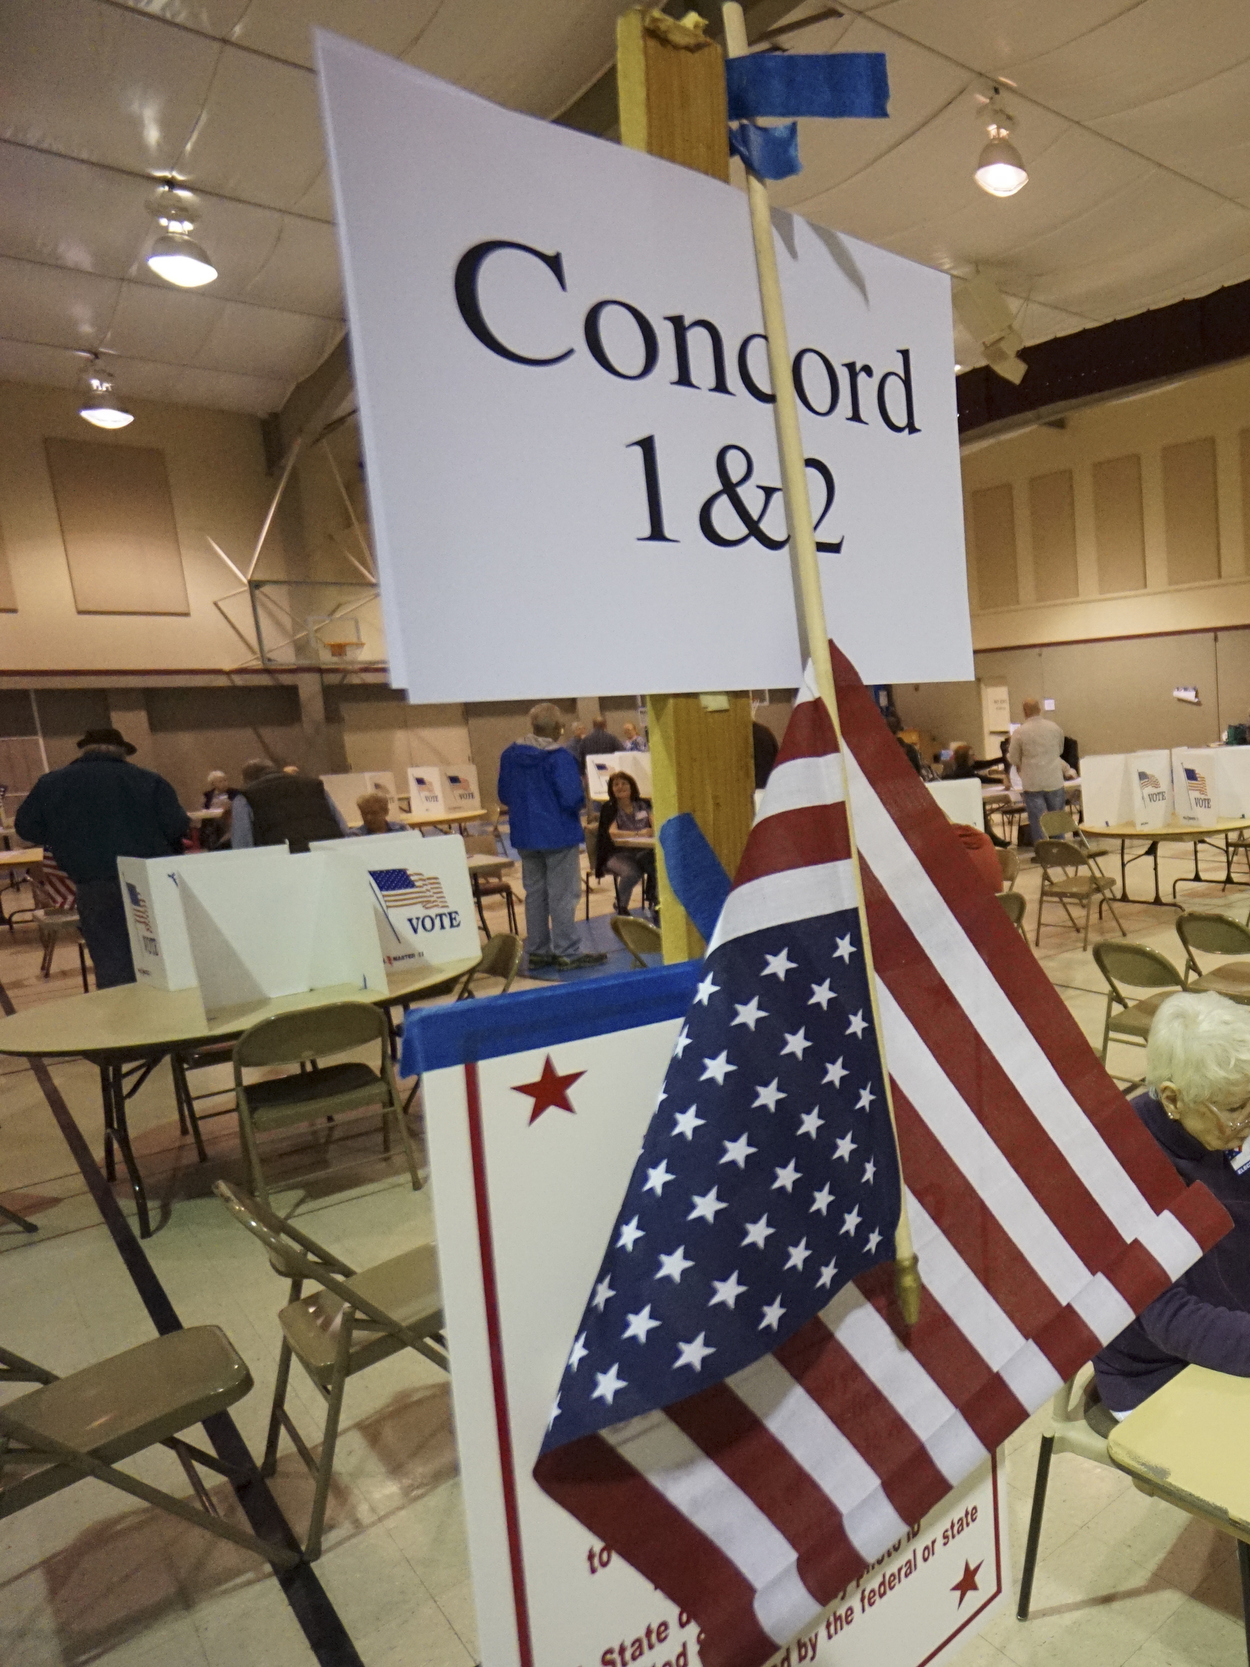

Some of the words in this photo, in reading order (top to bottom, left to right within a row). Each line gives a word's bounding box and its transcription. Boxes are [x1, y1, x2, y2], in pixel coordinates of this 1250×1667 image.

[454, 239, 921, 436] Concord
[624, 433, 845, 554] 1&2
[425, 795, 439, 803] VOTE
[458, 792, 475, 801] VOTE
[1148, 791, 1167, 803] VOTE
[1194, 797, 1212, 809] VOTE
[407, 910, 462, 935] VOTE
[586, 1544, 612, 1575] to
[796, 1631, 819, 1663] by
[825, 1605, 855, 1641] the
[860, 1548, 918, 1614] federal
[922, 1536, 937, 1563] or
[942, 1504, 979, 1548] state
[600, 1619, 670, 1667] State
